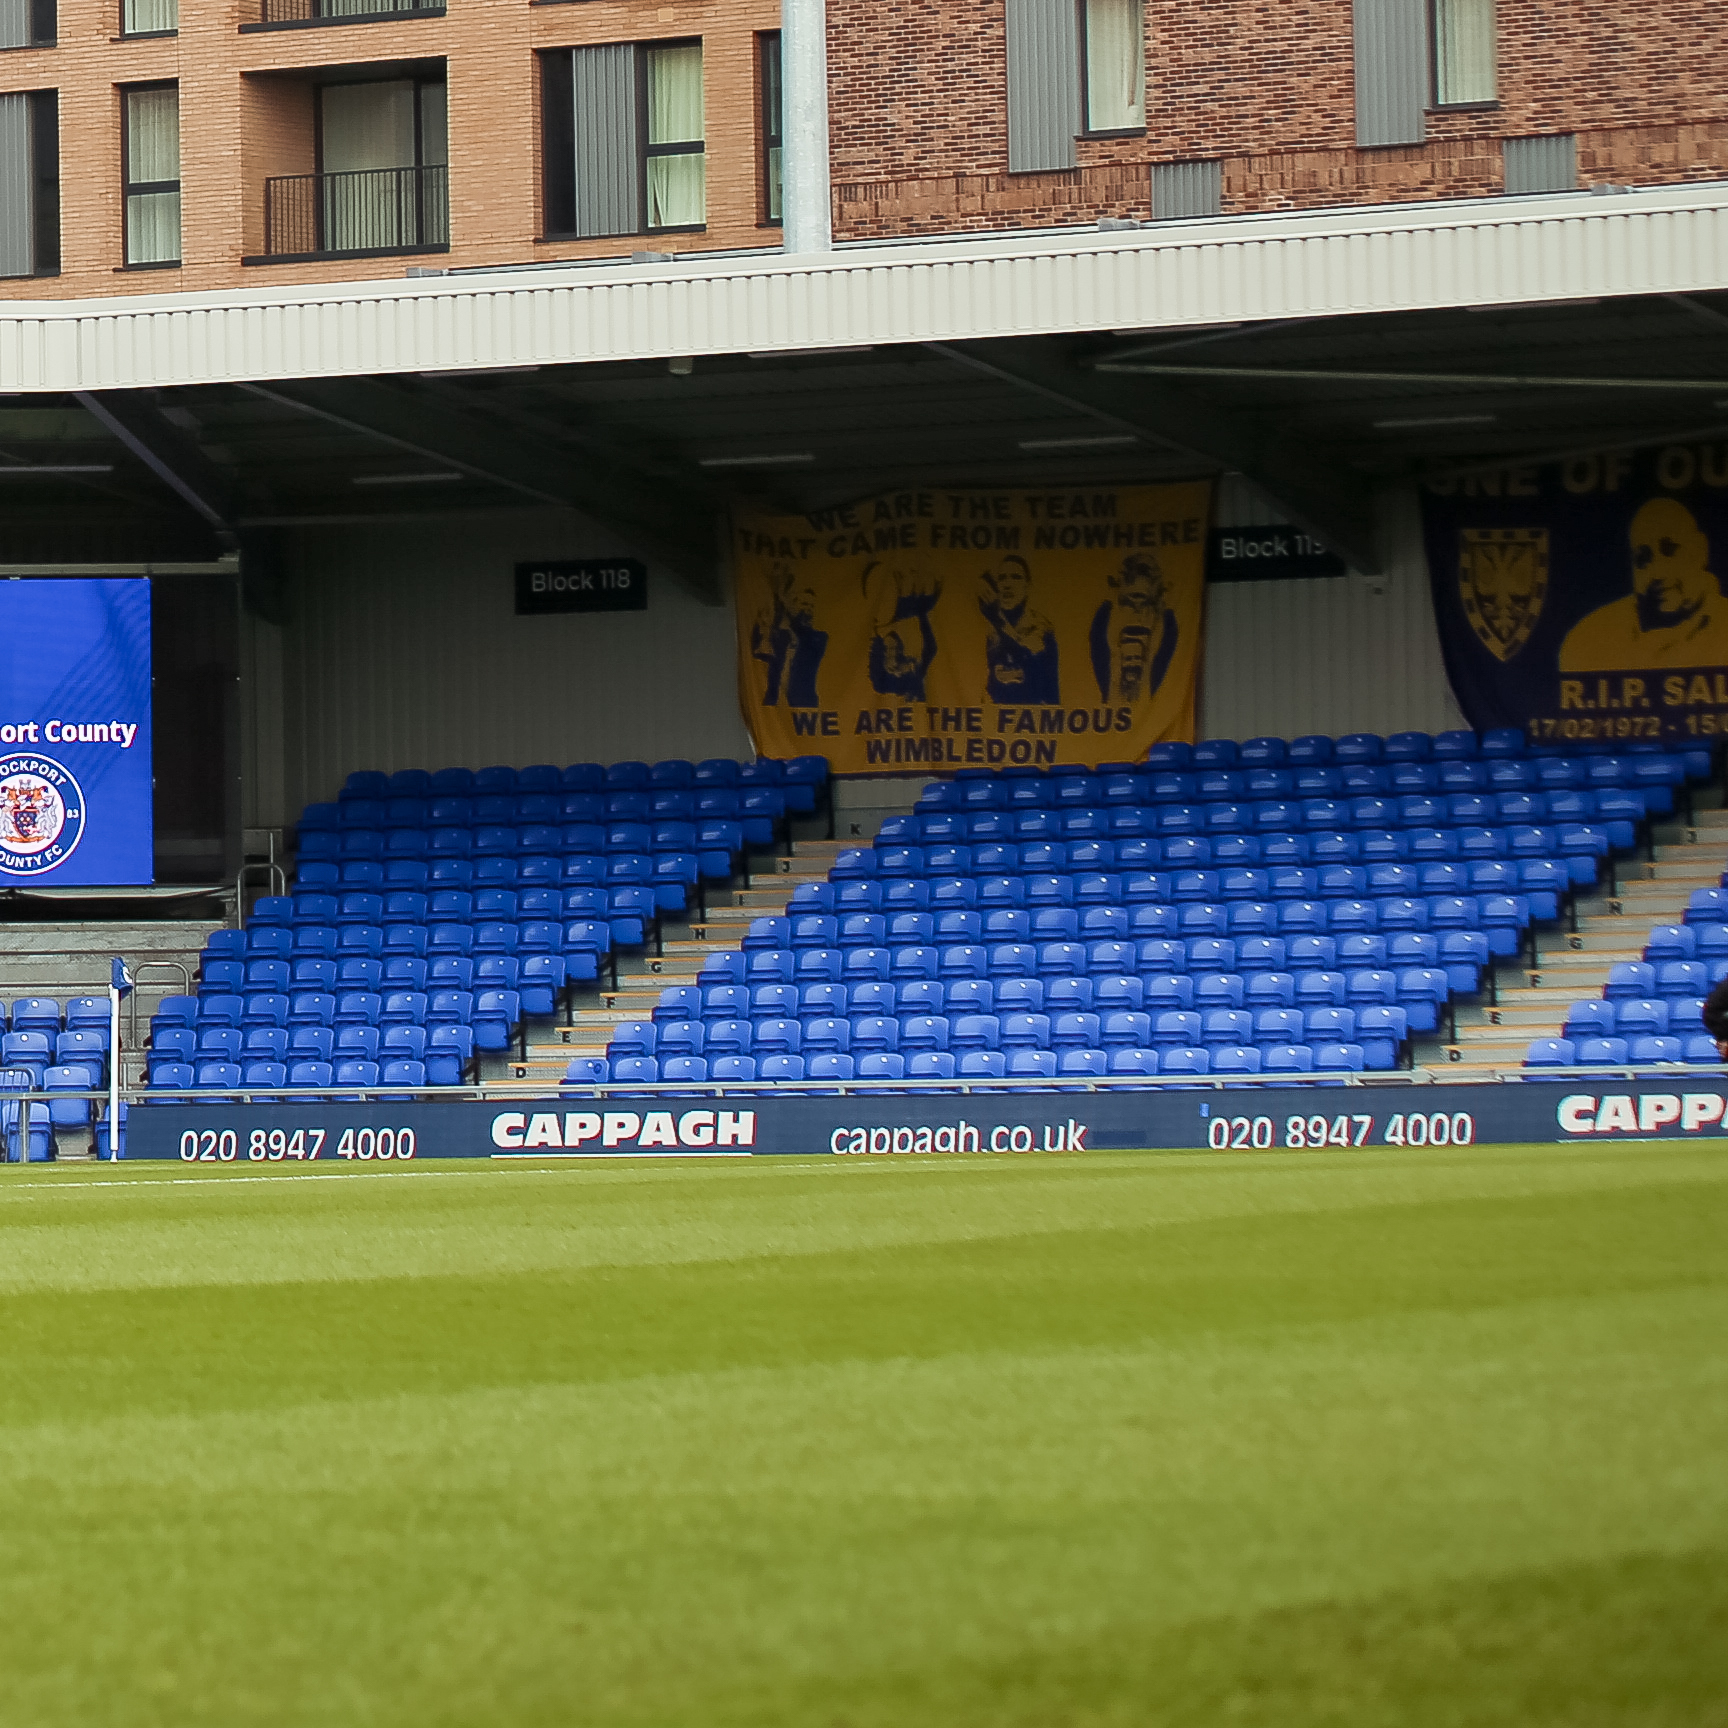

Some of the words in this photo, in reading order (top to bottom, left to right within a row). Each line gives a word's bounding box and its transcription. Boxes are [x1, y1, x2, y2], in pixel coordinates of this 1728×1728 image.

[1560, 450, 1634, 494] OF
[805, 509, 861, 532] WE
[873, 493, 934, 522] ARE
[946, 494, 1010, 520] THE
[1024, 493, 1117, 519] TEAM
[738, 528, 817, 560] THAT
[826, 525, 918, 557] CAME
[929, 525, 1019, 552] FROM
[1033, 518, 1203, 551] NOWHERE
[1221, 535, 1289, 559] Block
[531, 569, 594, 593] Block
[600, 568, 631, 590] 118
[1559, 678, 1649, 710] R.I.P.
[44, 719, 137, 749] County
[792, 711, 841, 736] WE
[853, 708, 914, 734] ARE
[926, 707, 982, 733] THE
[995, 705, 1132, 734] FAMOUS
[866, 737, 1057, 764] WIMBLEDON
[44, 844, 63, 861] FC
[490, 1110, 756, 1148] CAPPAGH
[1556, 1092, 1728, 1134] CAPP
[179, 1129, 238, 1161] 020
[248, 1128, 327, 1161] 8947
[336, 1127, 417, 1160] 4000
[830, 1117, 1088, 1154] cappagh.co.uk
[1208, 1115, 1274, 1150] 020
[1285, 1114, 1373, 1149] 8947
[1384, 1112, 1475, 1147] 4000
